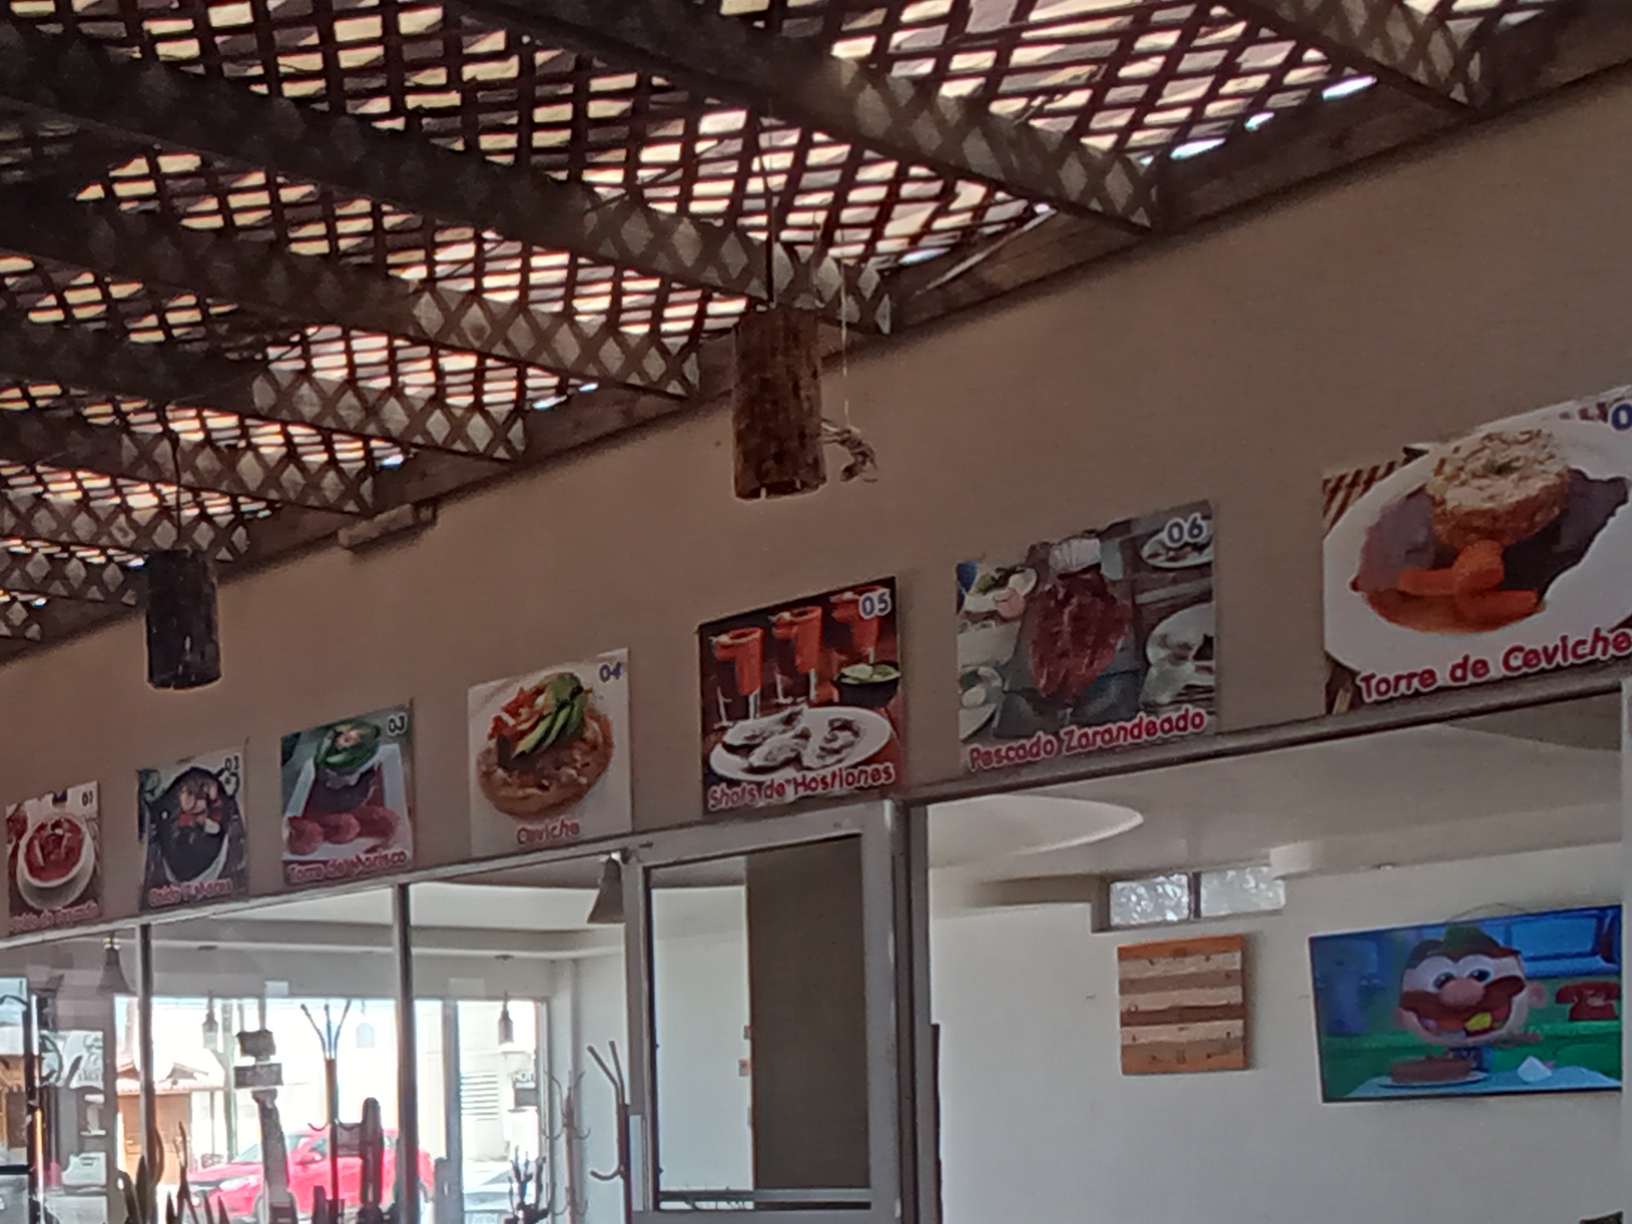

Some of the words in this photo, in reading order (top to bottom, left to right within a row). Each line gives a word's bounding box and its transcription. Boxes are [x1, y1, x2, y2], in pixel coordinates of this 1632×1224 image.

[1168, 515, 1206, 545] 06
[859, 592, 891, 617] 05
[599, 661, 623, 682] 04
[1361, 667, 1438, 699] Torre
[1449, 655, 1490, 684] de
[1502, 626, 1632, 670] Ceviche
[969, 734, 1055, 770] Pescado
[1062, 708, 1206, 752] Zarandeado
[763, 777, 787, 800] de
[792, 763, 894, 796] Hostiones
[81, 789, 94, 807] 01
